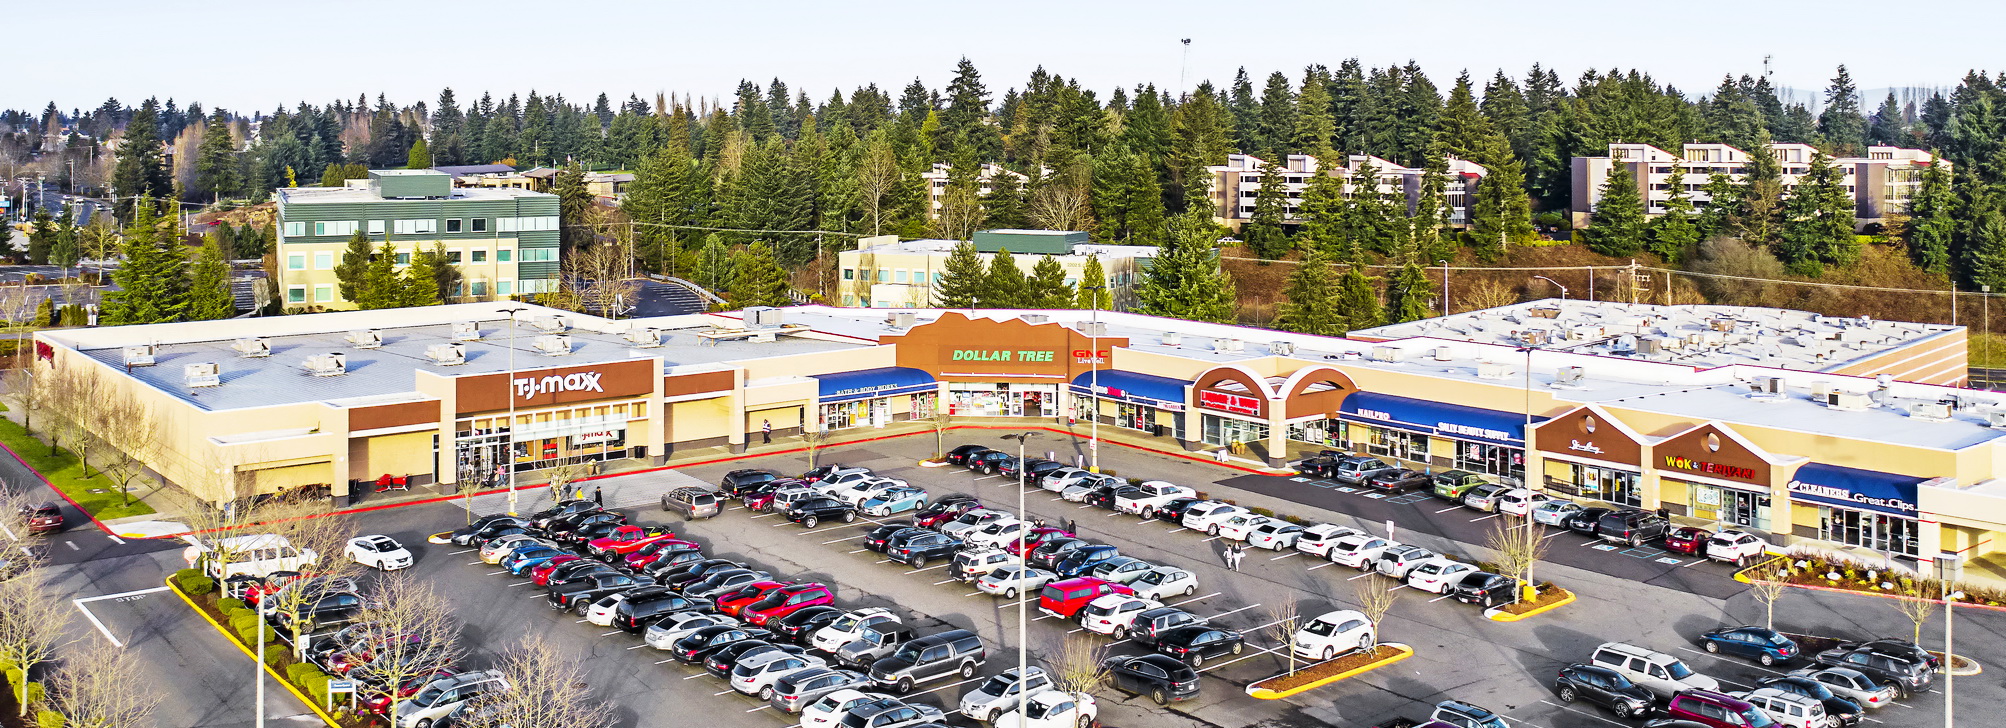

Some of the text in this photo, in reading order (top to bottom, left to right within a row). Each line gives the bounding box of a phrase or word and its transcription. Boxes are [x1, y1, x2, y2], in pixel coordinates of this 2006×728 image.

[952, 350, 1054, 362] DOLLAR TREE
[1072, 350, 1108, 358] GNC
[836, 387, 853, 395] BATH
[1665, 455, 1692, 470] WOK
[1700, 461, 1755, 479] TERIYAKI
[1800, 483, 1850, 499] CLEANERS
[1854, 493, 1885, 507] Great
[115, 594, 147, 603] STOP
